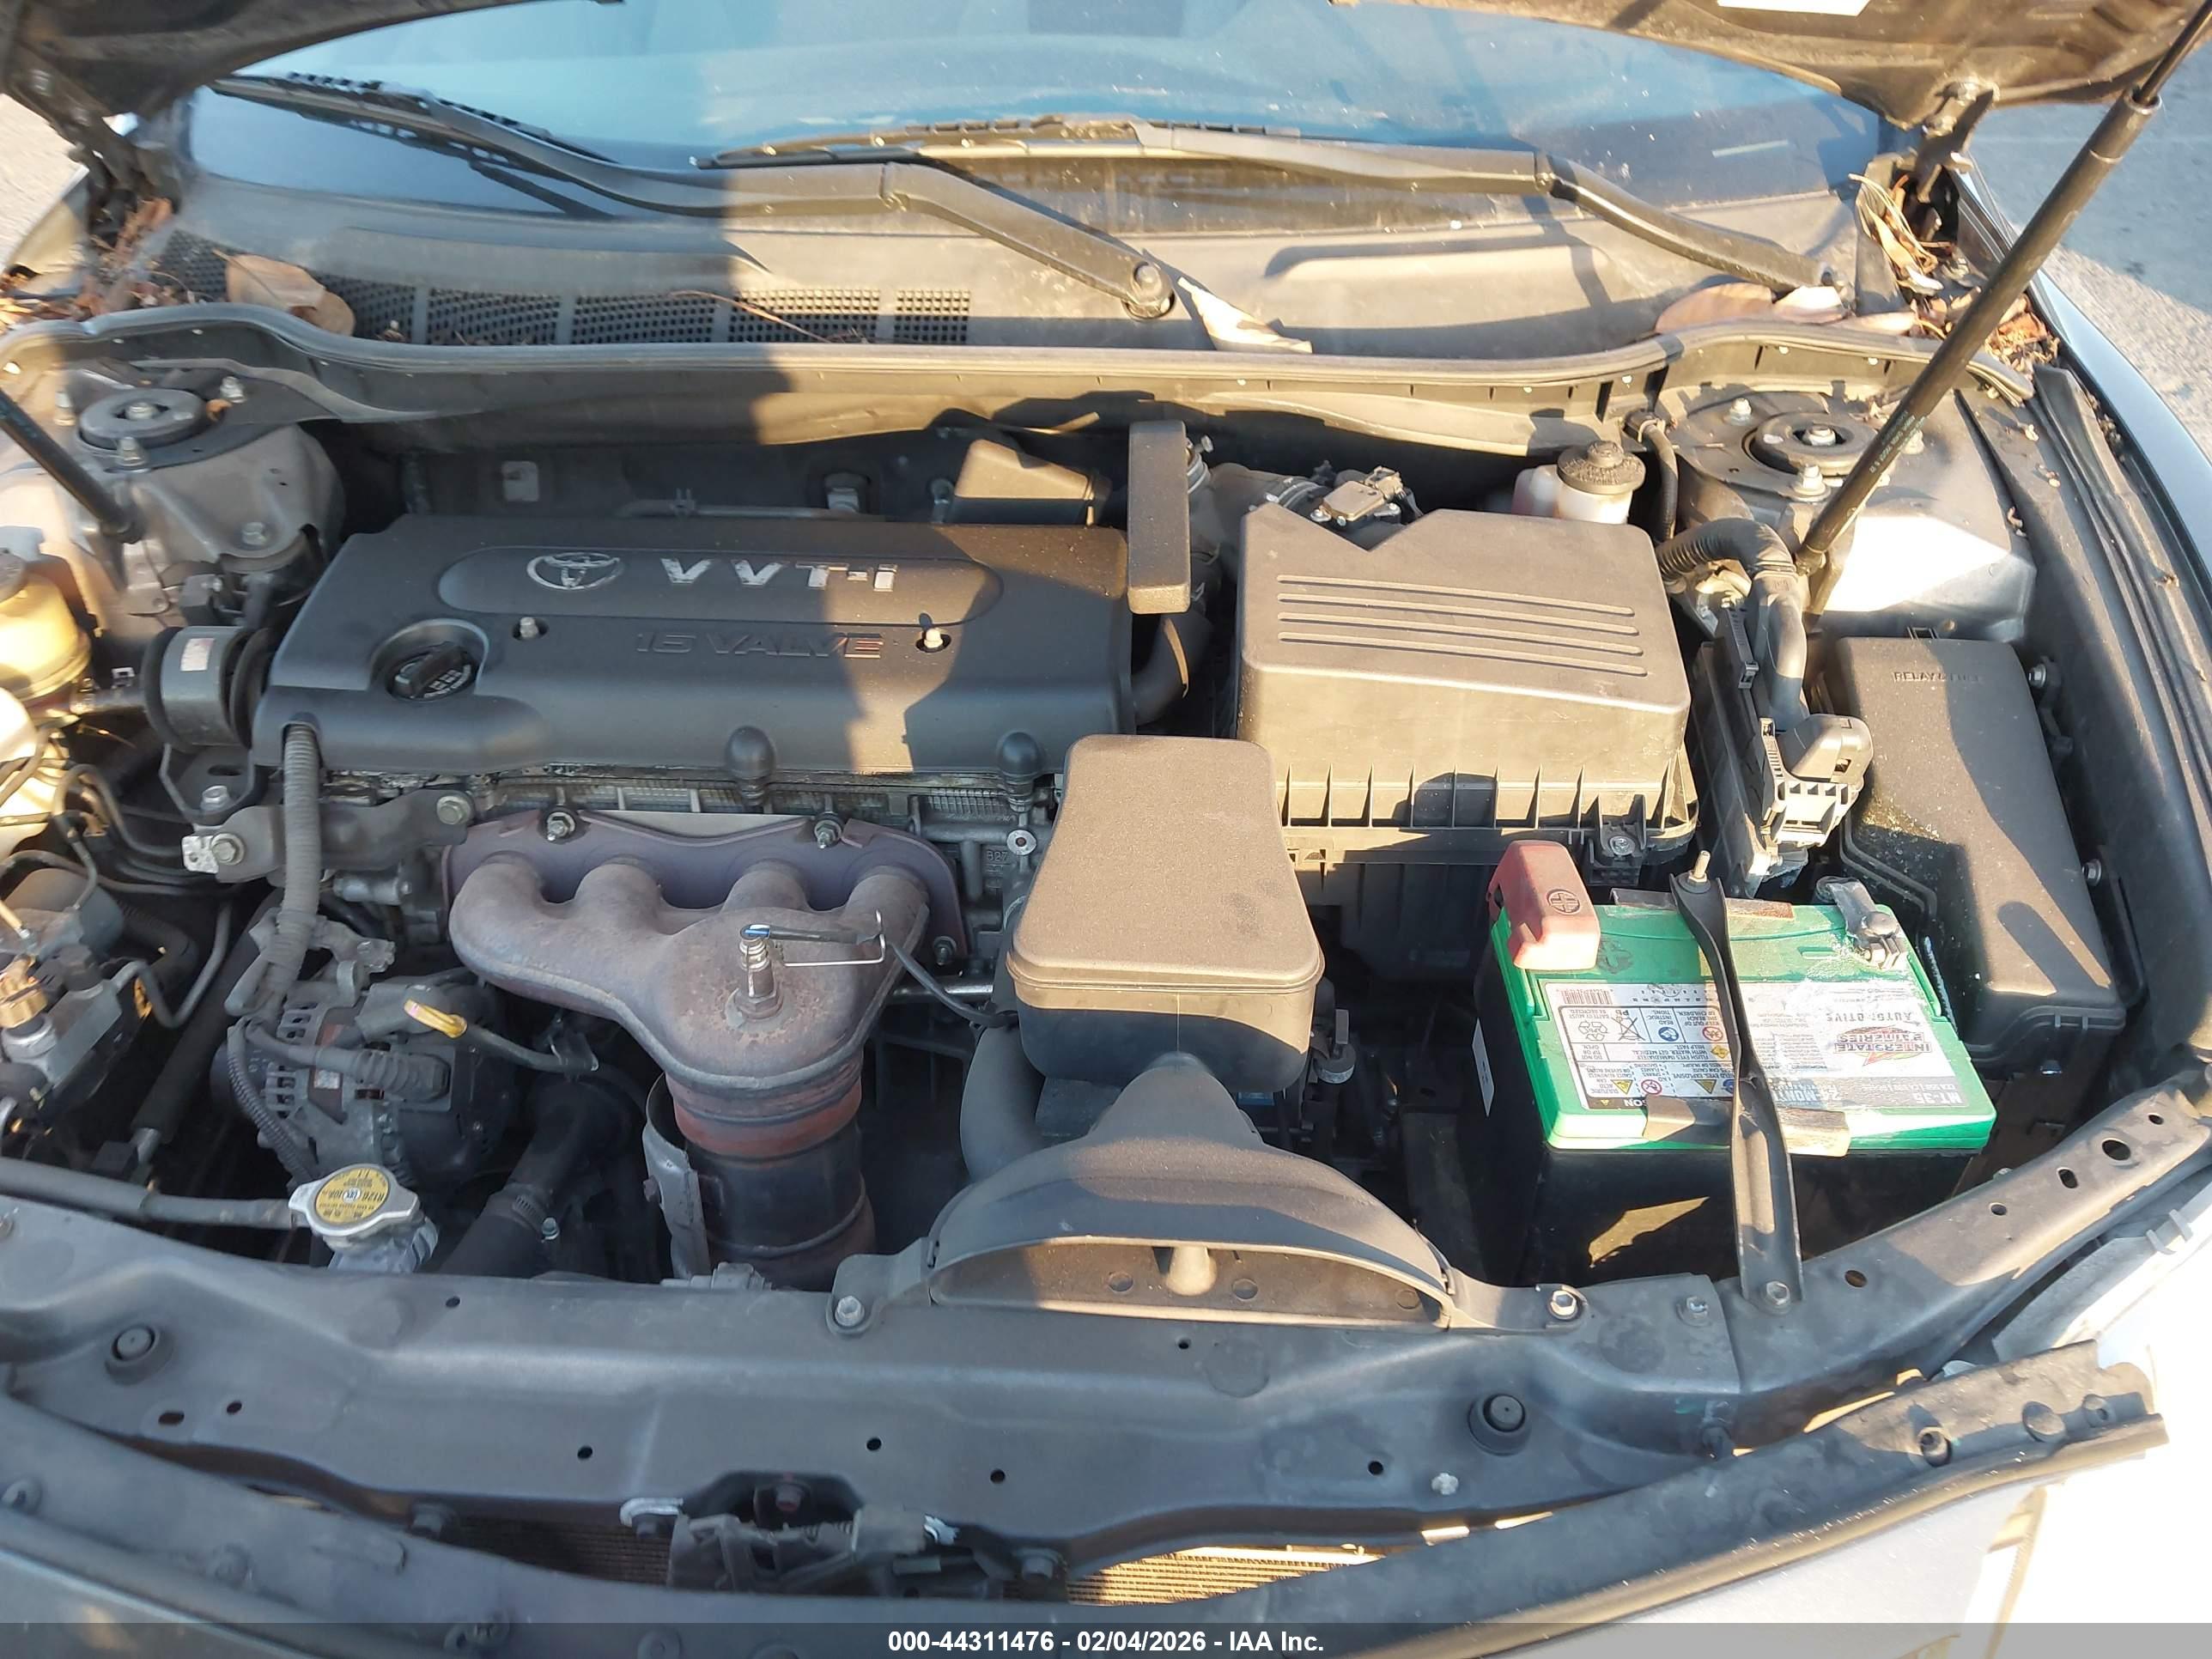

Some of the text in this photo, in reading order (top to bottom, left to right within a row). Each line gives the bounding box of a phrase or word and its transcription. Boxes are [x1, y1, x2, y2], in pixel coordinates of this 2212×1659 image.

[636, 632, 884, 659] 16 VALVE
[1893, 672, 1935, 682] RELAY
[1839, 1034, 1923, 1042] BATTERIES
[1912, 1092, 1962, 1103] MT-35
